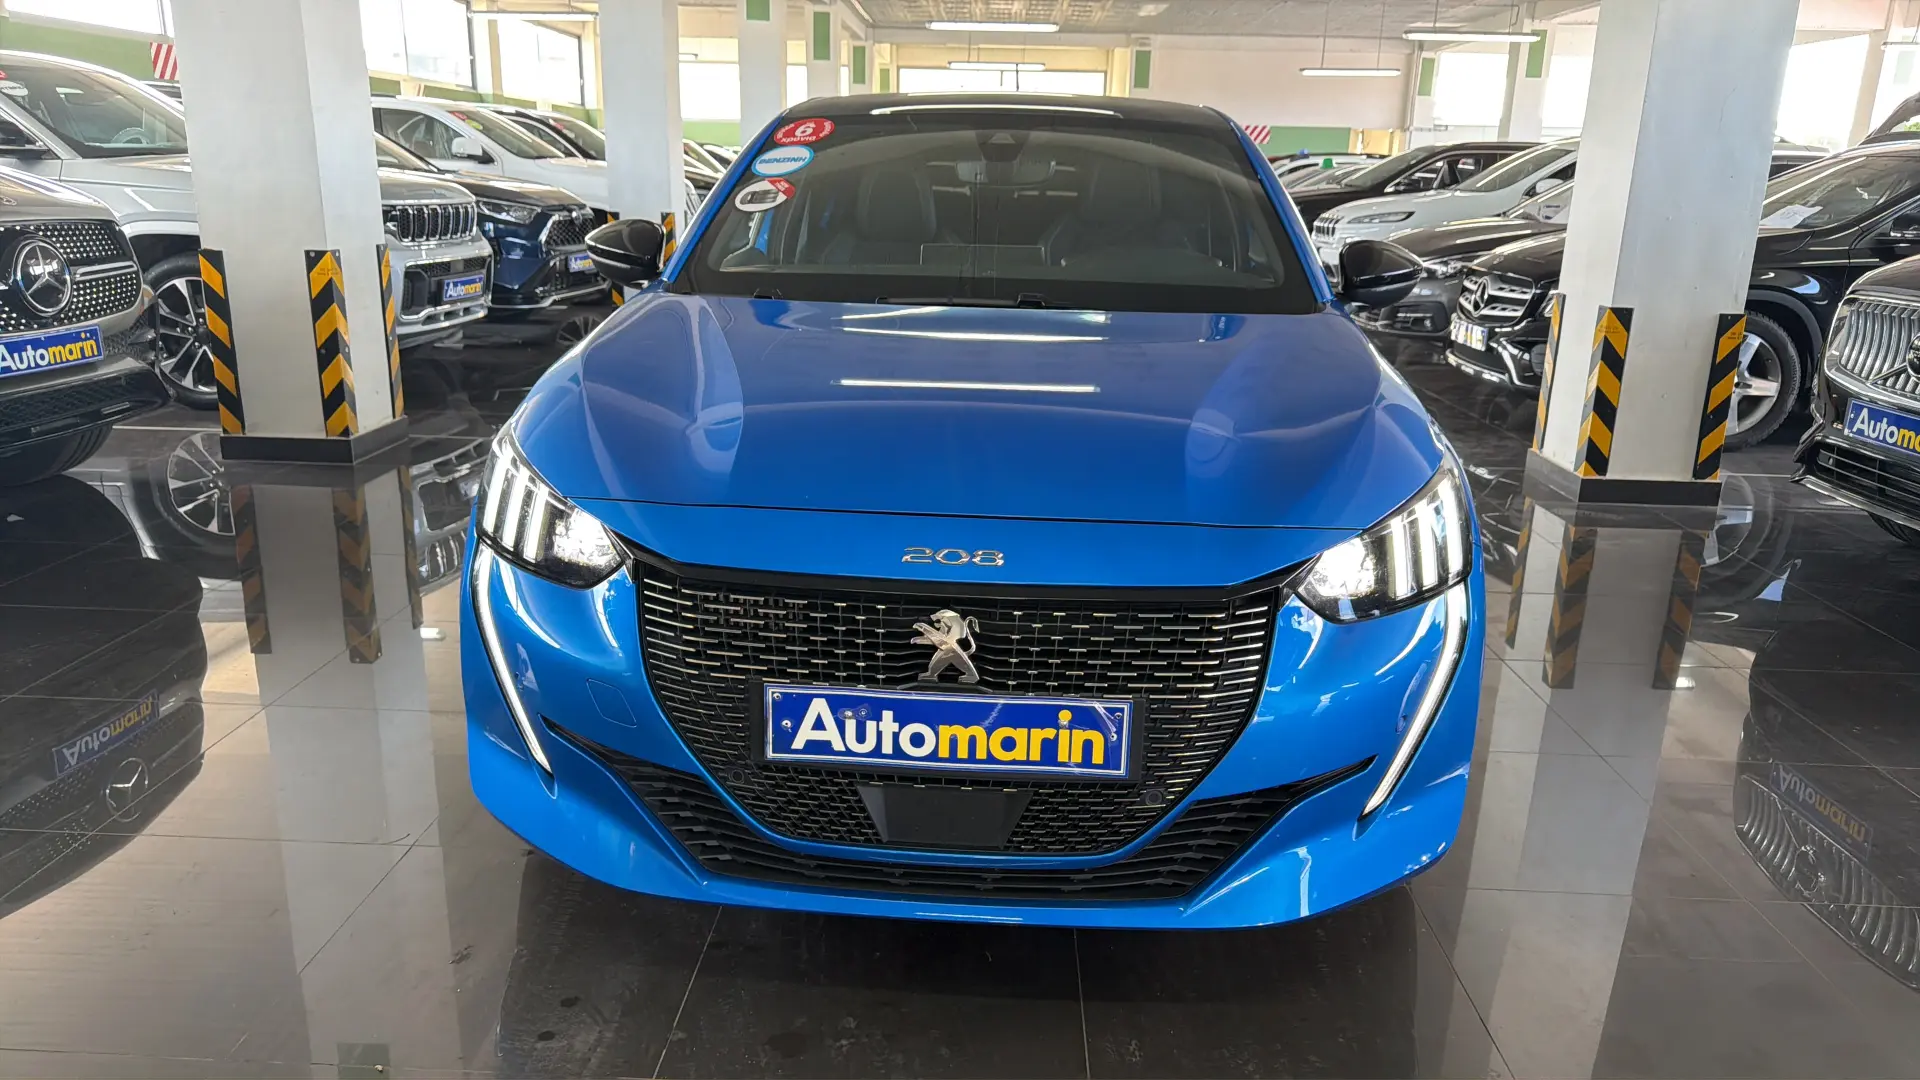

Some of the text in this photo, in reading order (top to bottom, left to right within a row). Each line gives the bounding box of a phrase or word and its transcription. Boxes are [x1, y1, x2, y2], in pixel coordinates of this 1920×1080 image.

[795, 122, 816, 137] 6
[901, 547, 1005, 566] 208
[791, 697, 1105, 765] Automarin
